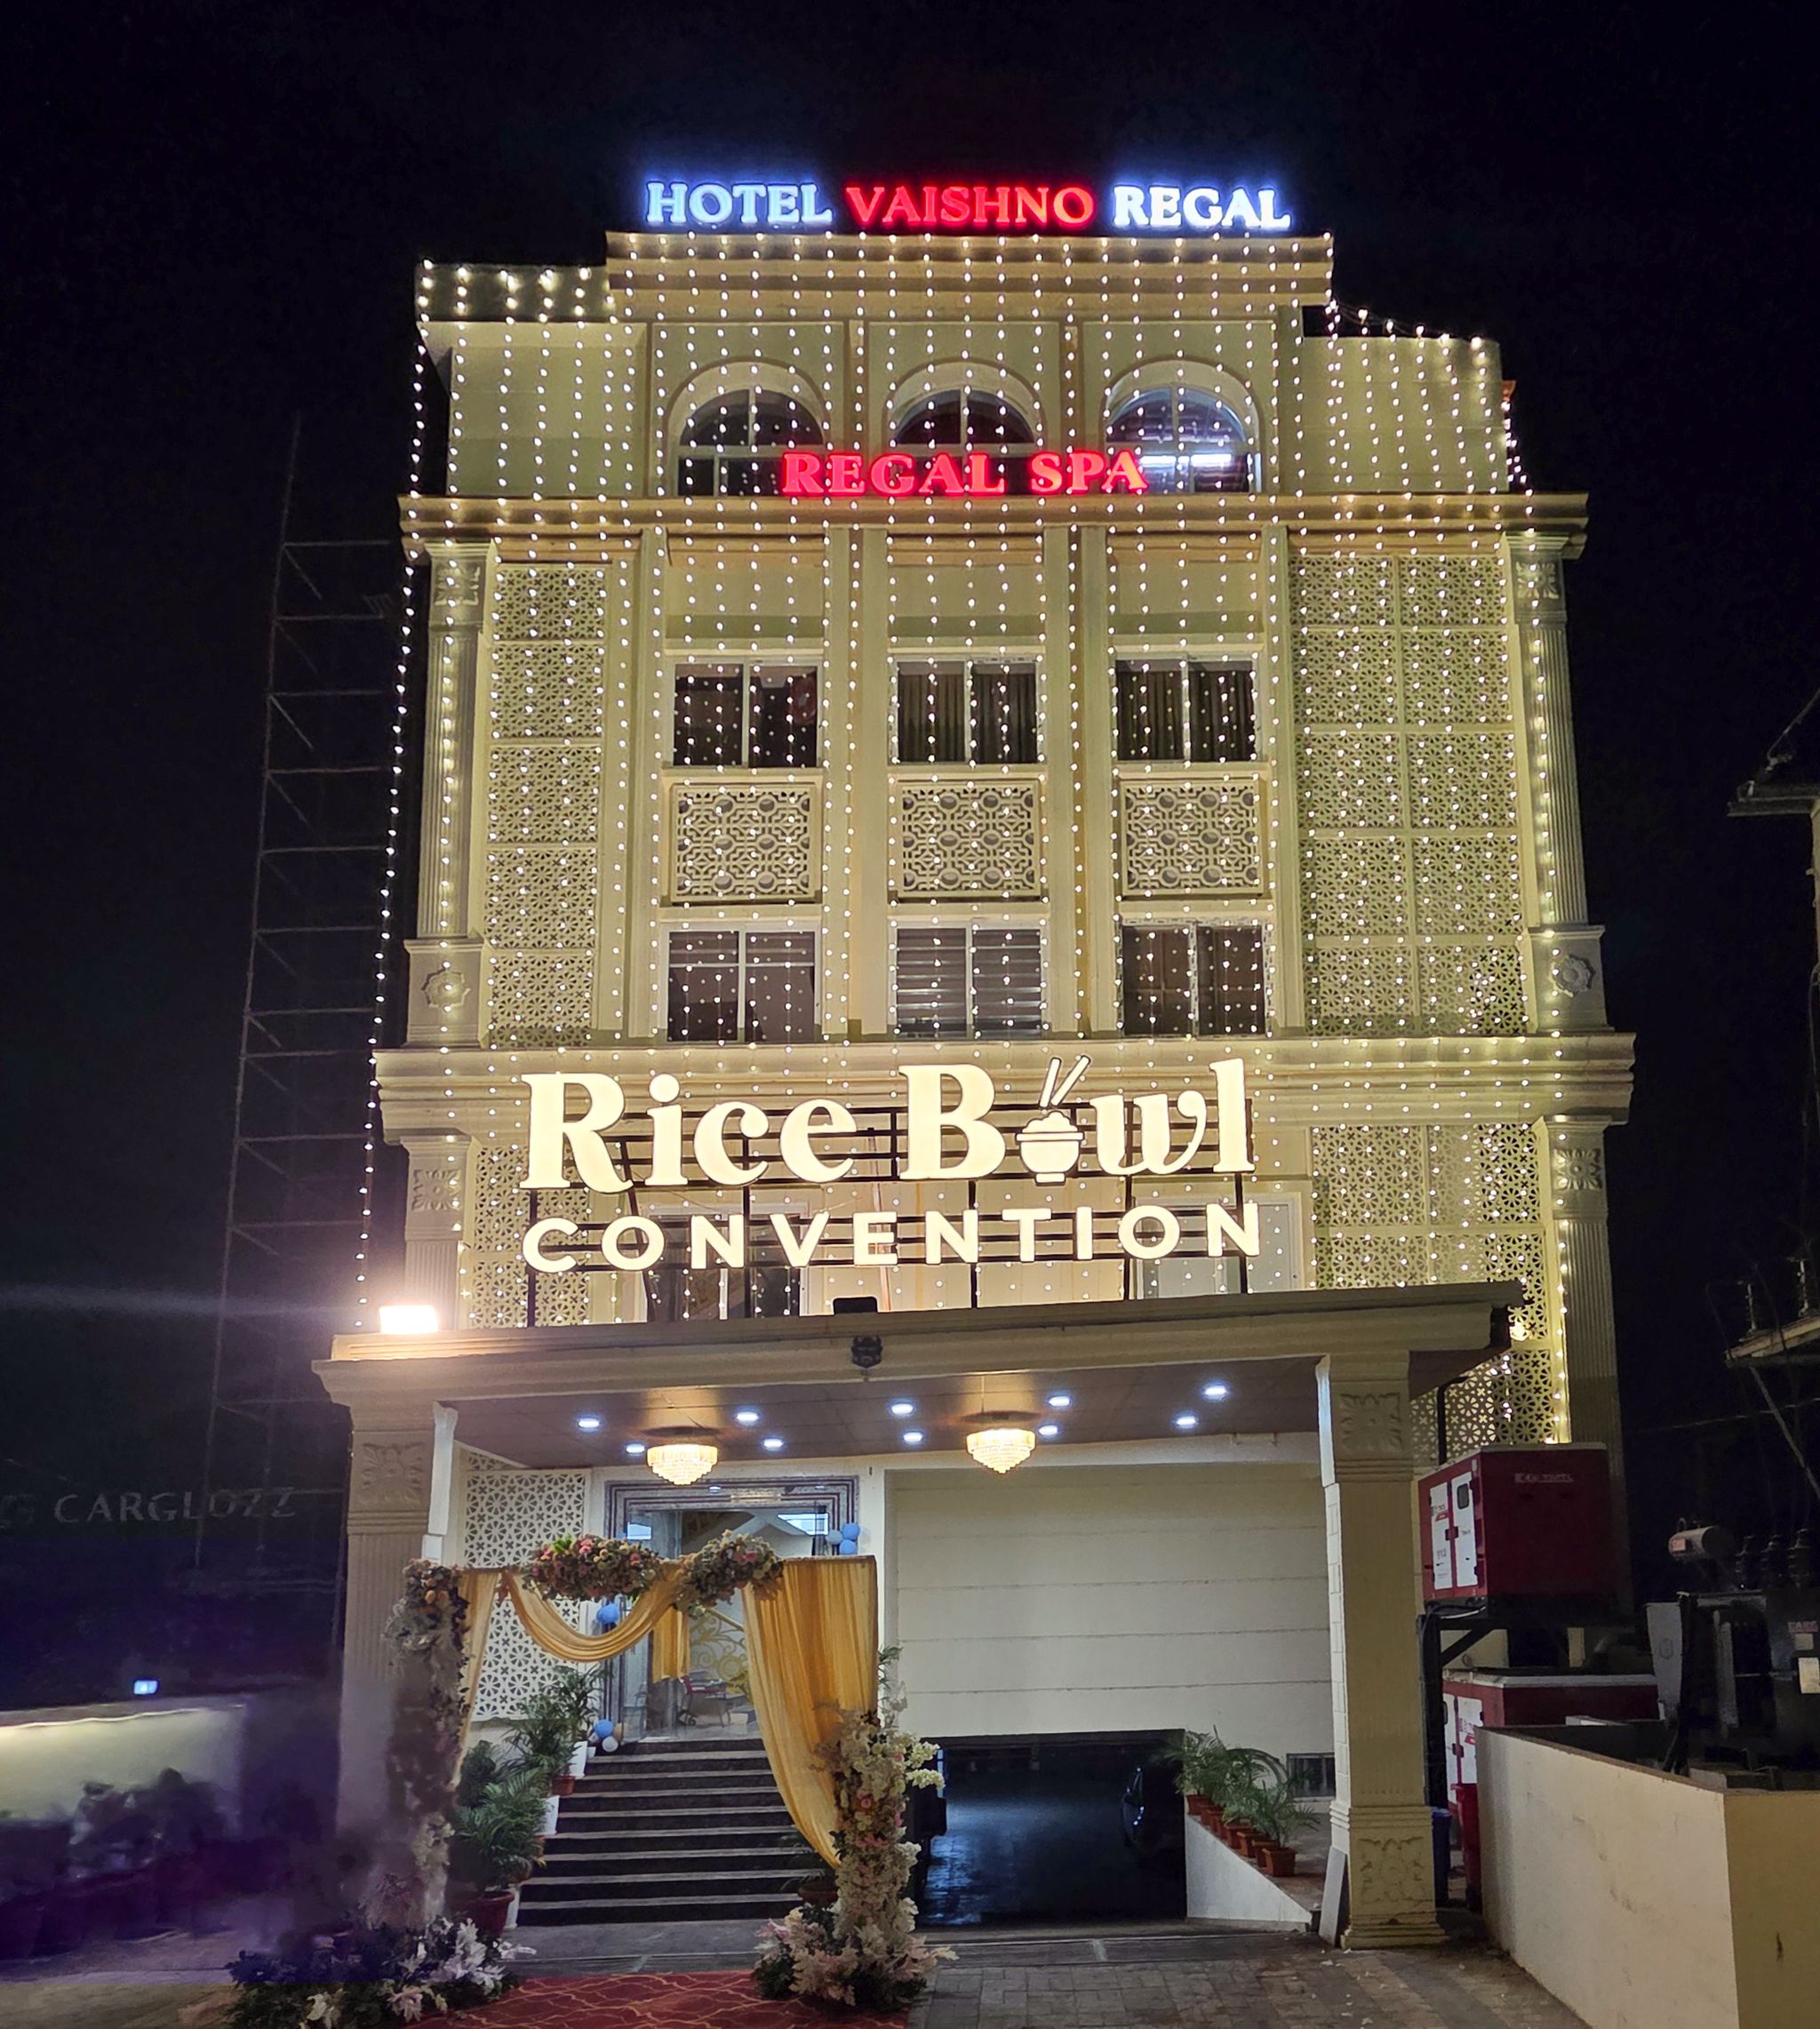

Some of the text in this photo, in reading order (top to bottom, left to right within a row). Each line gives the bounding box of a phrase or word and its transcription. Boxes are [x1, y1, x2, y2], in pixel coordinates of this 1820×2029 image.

[646, 182, 1291, 228] HOTEL VAISHNO REGAL
[782, 450, 1148, 494] REGAL SPA
[519, 1072, 858, 1194] Rice
[522, 1202, 1260, 1274] CONVENTION
